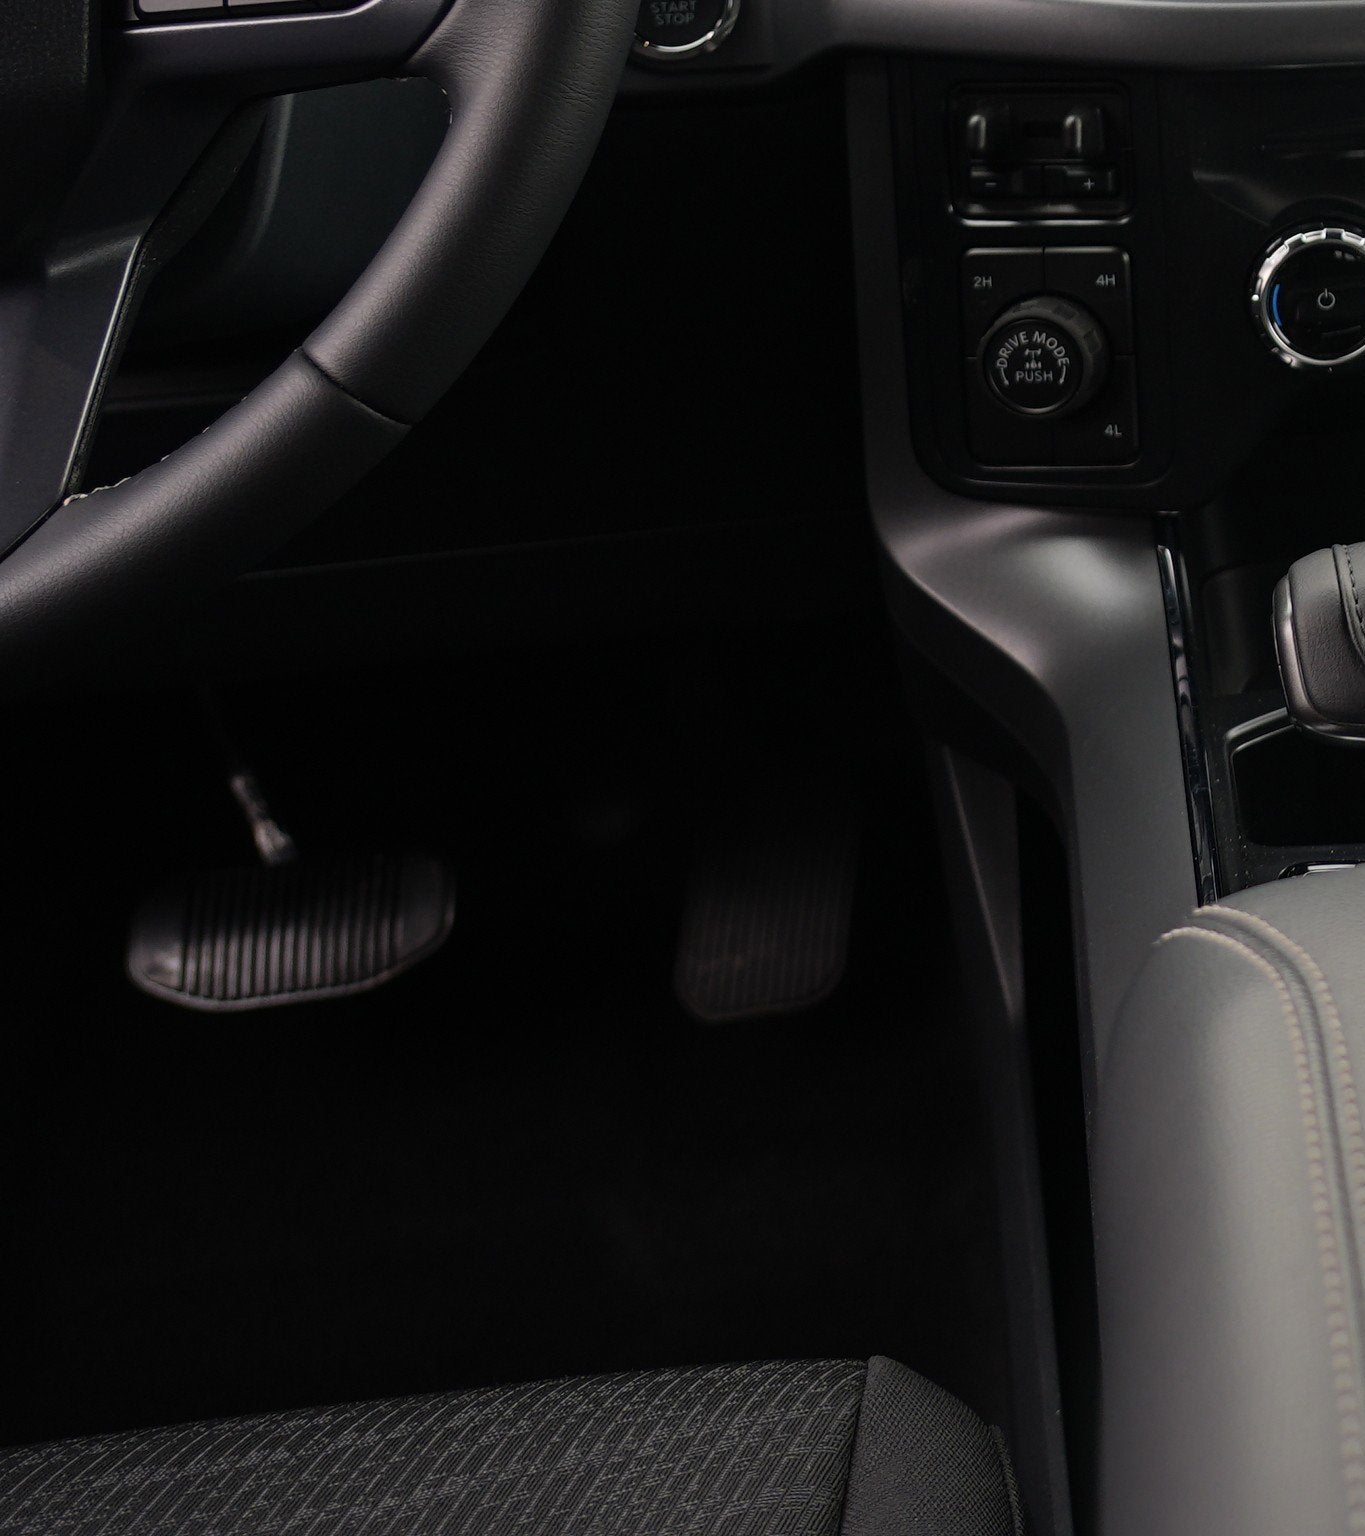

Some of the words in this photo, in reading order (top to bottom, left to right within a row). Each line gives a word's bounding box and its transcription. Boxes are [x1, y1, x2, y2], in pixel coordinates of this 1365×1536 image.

[650, 0, 697, 13] START
[655, 13, 695, 25] STOP
[973, 276, 993, 287] 2H
[1096, 274, 1116, 286] 4H
[996, 331, 1029, 368] DRIVE
[1032, 330, 1070, 366] MODE
[1015, 370, 1053, 383] PUSH
[1104, 424, 1123, 436] 4L
